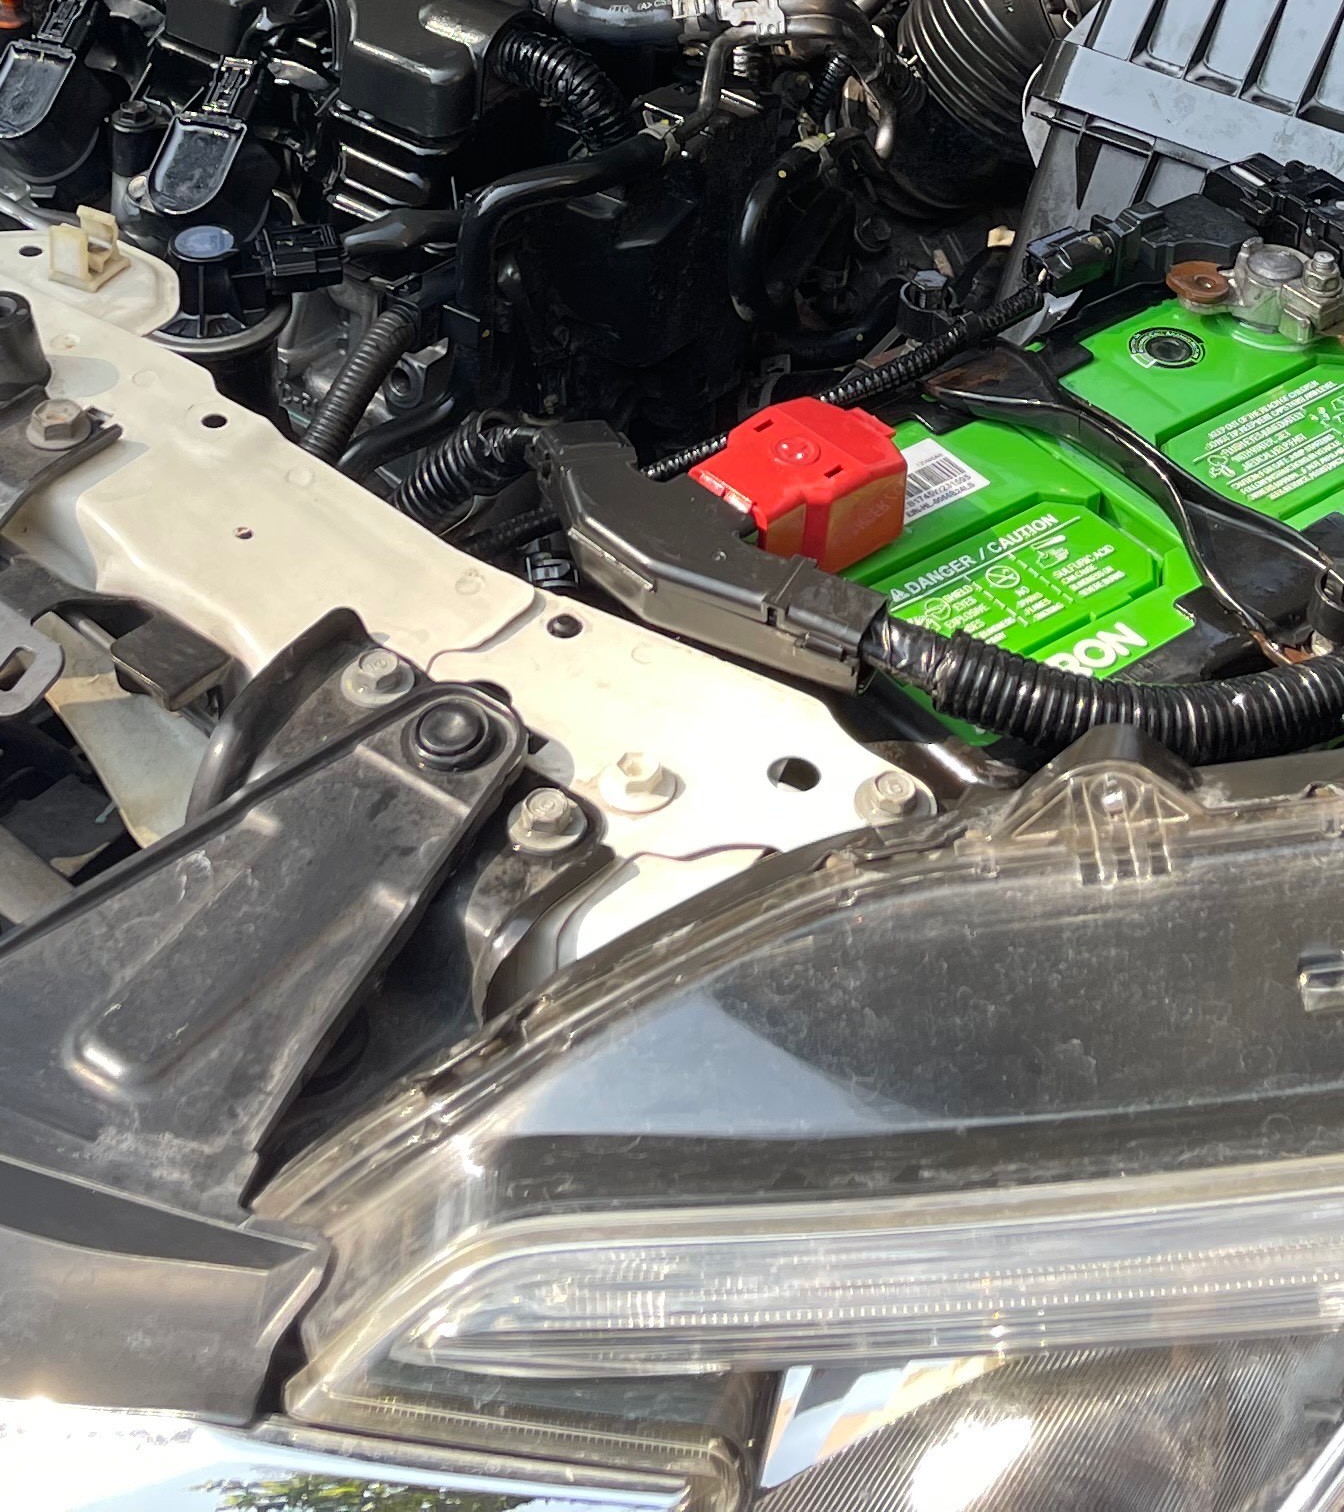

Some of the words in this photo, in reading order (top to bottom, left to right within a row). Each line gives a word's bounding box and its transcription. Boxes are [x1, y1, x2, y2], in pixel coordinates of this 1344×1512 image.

[904, 554, 977, 595] DANGER
[987, 514, 1059, 554] CAUTION
[1052, 555, 1096, 578] SULFURIC
[1093, 544, 1115, 560] ACID
[1045, 621, 1148, 677] RON
